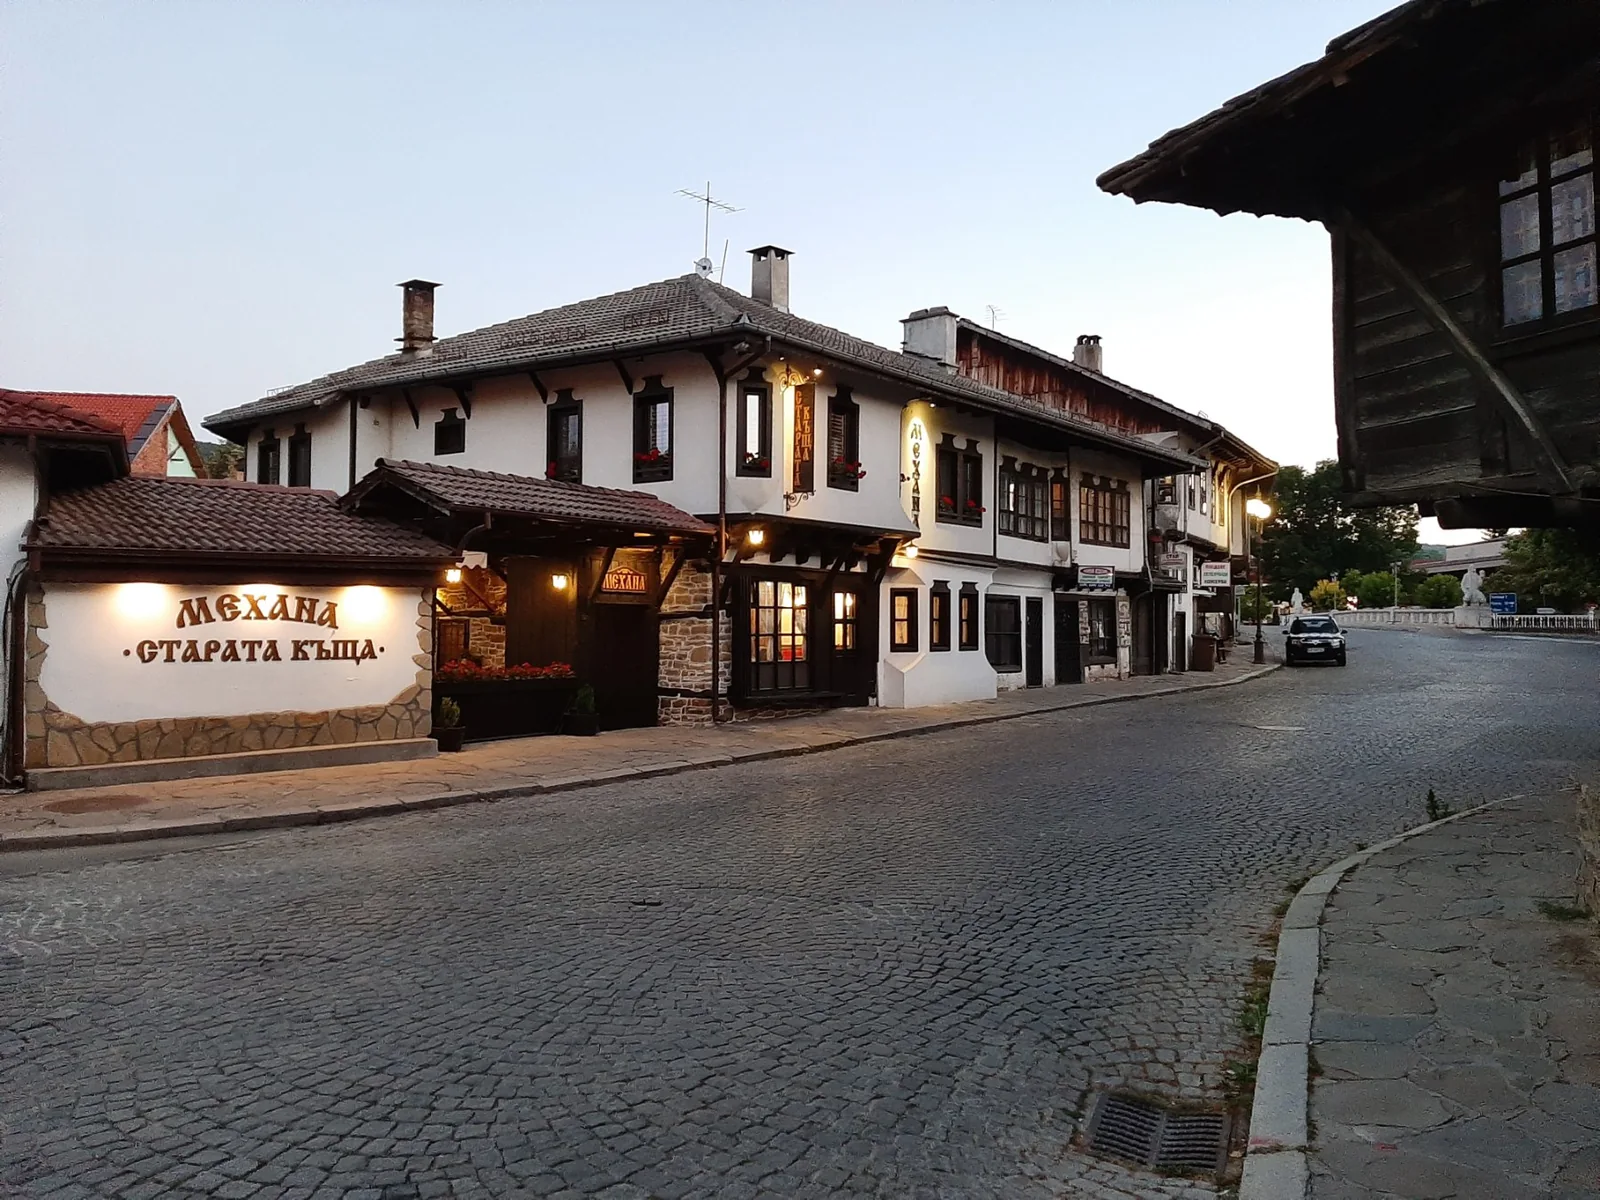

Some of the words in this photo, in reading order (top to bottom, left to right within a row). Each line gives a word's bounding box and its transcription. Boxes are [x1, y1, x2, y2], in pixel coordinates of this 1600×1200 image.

[801, 406, 812, 461] КЪЩА
[176, 593, 339, 629] МЕХАНА
[136, 639, 282, 663] СТАРАТА
[290, 638, 377, 665] КЪЩА
